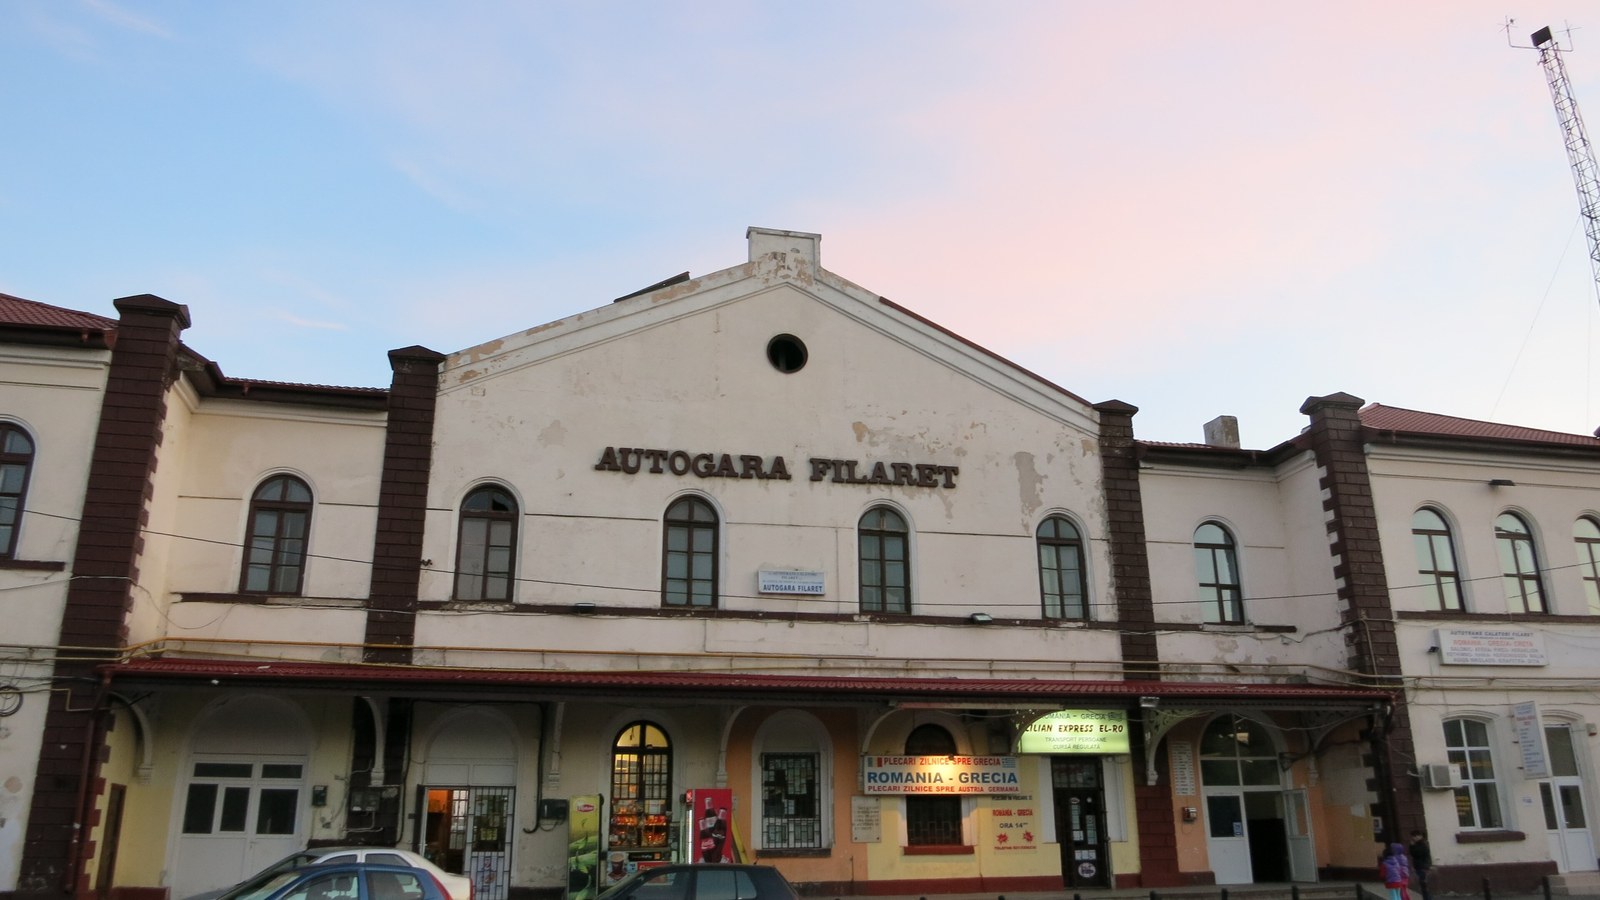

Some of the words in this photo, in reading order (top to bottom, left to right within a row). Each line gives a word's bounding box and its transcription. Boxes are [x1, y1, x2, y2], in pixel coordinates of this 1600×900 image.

[594, 447, 792, 480] AUTOGARA
[809, 457, 960, 488] FILARET
[762, 584, 796, 592] AUTOGARA
[797, 585, 823, 593] FILARET
[1058, 724, 1094, 733] EXPRESS
[1099, 724, 1124, 733] EL-RO
[883, 756, 916, 766] PLECARI
[919, 756, 949, 766] ZILNICE
[952, 756, 972, 766] SPRE
[973, 757, 1001, 767] GRECIA
[867, 771, 944, 784] ROMANIA
[958, 771, 1018, 784] GRECIA
[903, 785, 933, 793] ZILNICE
[935, 785, 955, 793] SPRE
